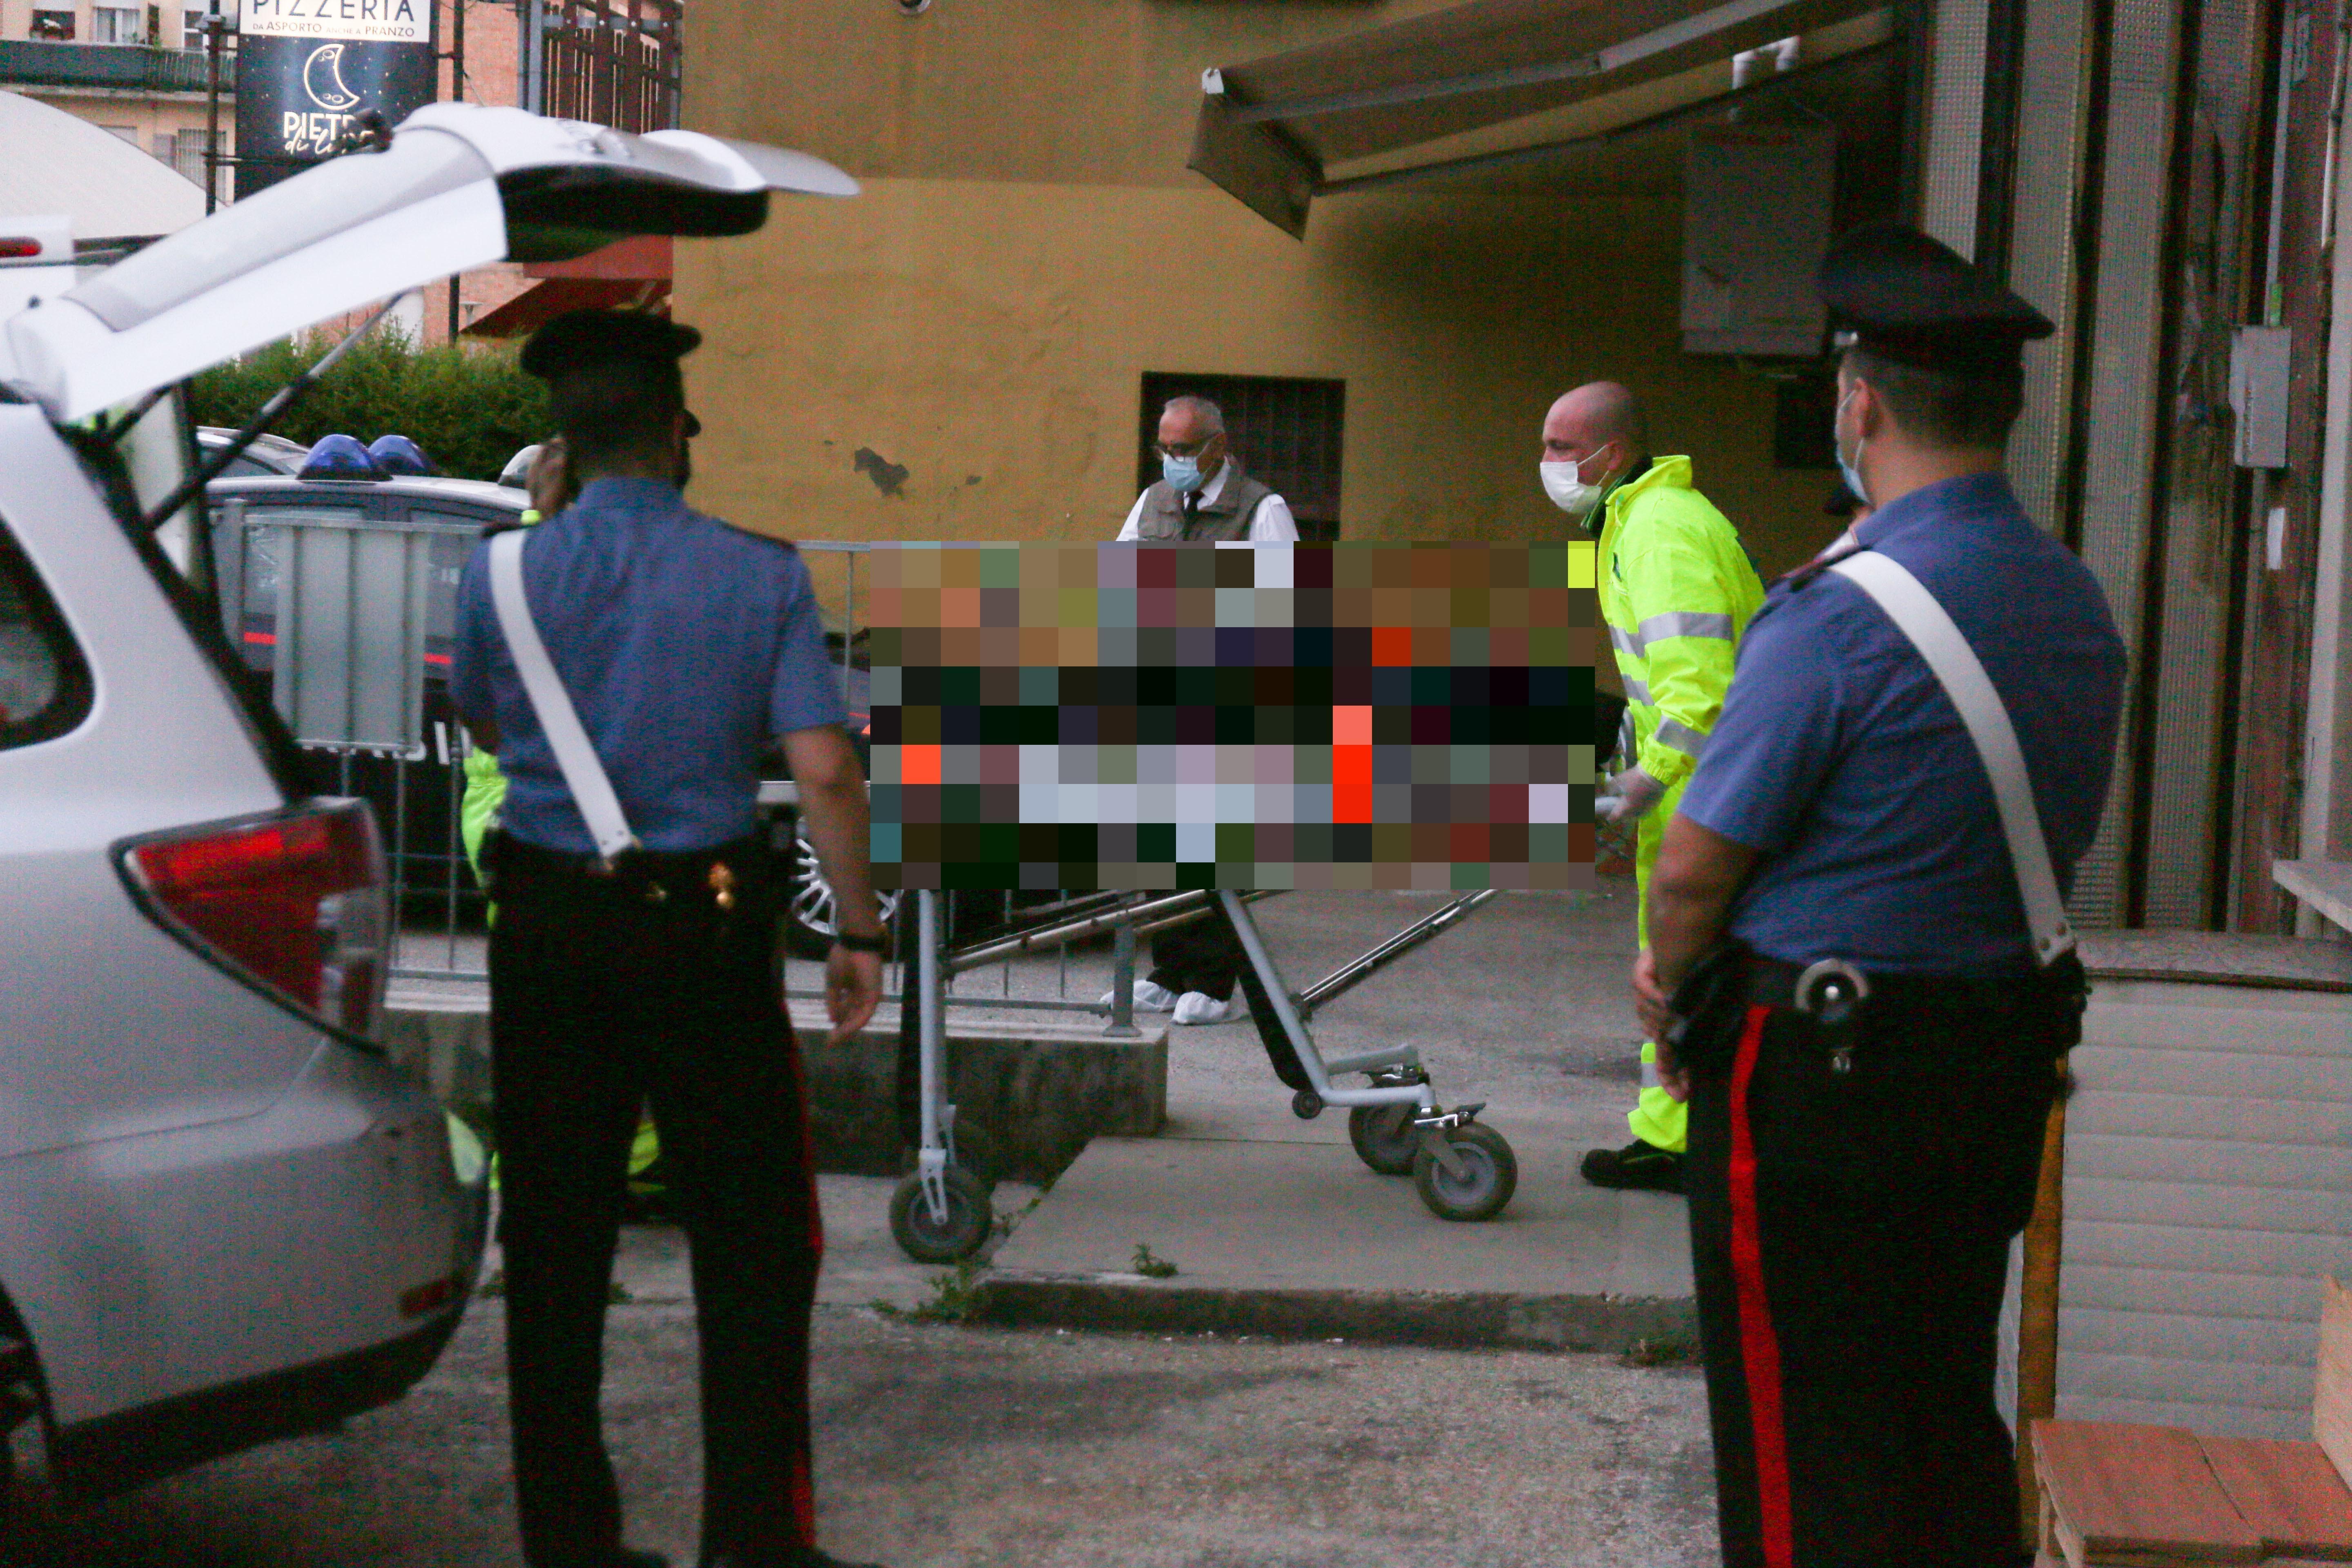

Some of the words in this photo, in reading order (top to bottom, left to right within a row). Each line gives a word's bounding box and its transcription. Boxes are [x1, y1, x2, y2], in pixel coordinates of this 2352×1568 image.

[254, 0, 414, 21] PIZZERIA
[266, 21, 321, 32] ASPORTO
[365, 26, 414, 37] PRANZO
[284, 111, 374, 141] PIET
[285, 125, 309, 155] di
